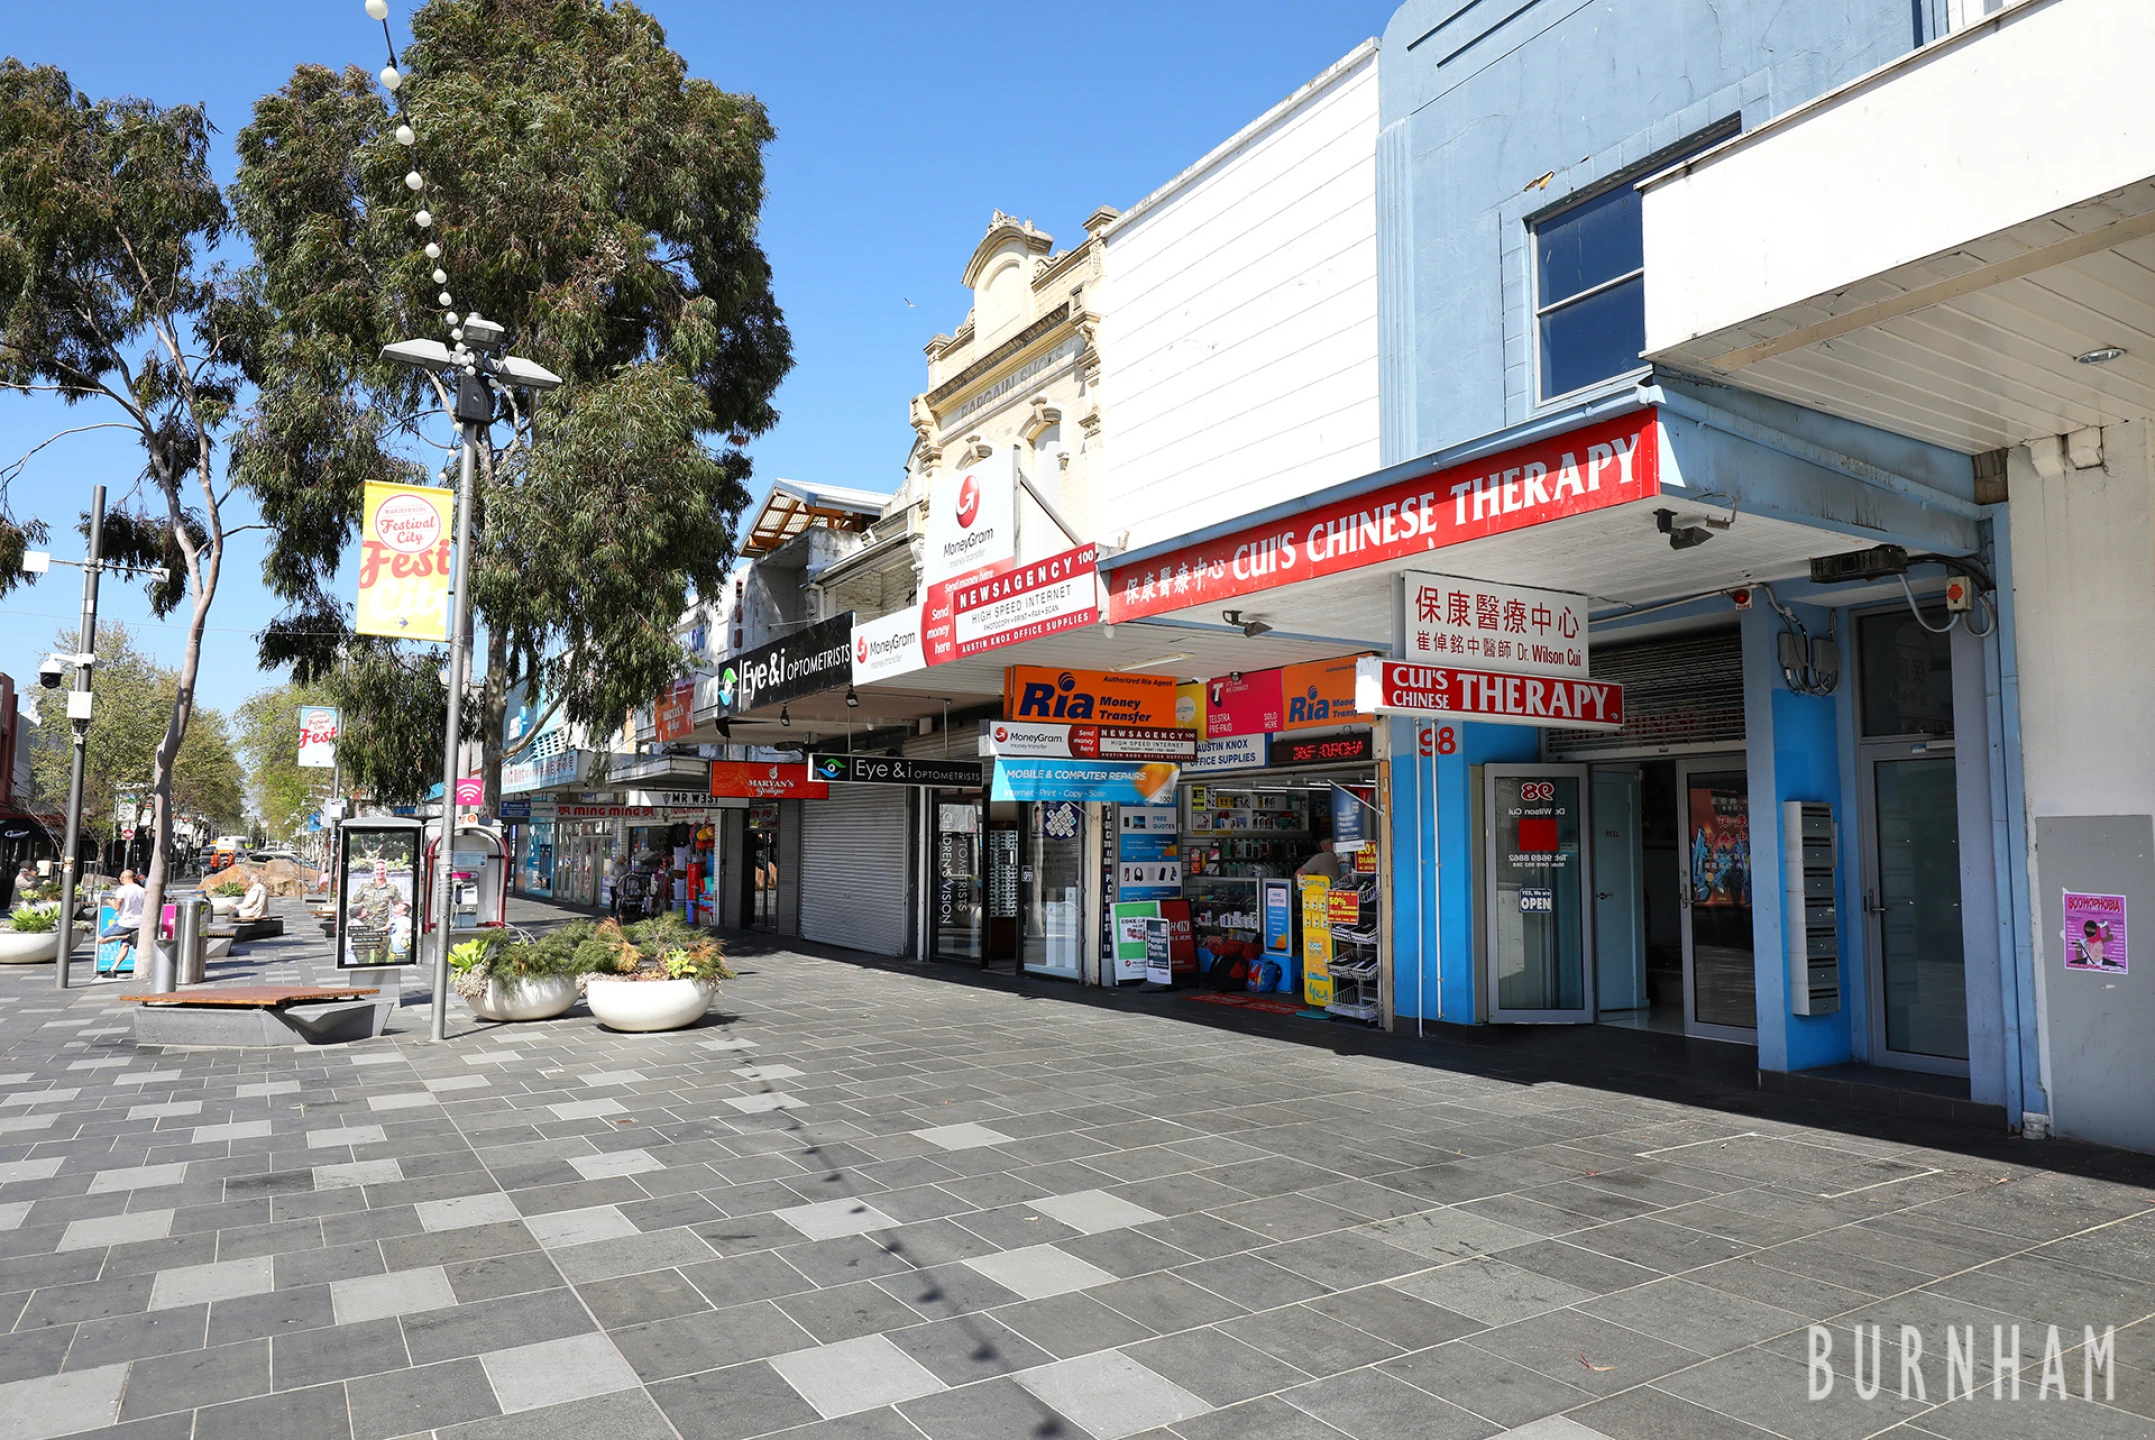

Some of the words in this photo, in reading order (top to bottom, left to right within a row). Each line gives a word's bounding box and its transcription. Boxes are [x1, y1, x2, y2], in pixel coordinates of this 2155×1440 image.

[961, 376, 1016, 420] BARGAIN
[1020, 346, 1066, 390] SHOES
[1233, 531, 1296, 580] CUI'S
[1306, 492, 1437, 562] CHINESE
[1450, 433, 1639, 526] THERAPY
[380, 515, 436, 533] Festival
[397, 531, 424, 545] City
[943, 527, 994, 558] MoneyGram
[950, 557, 970, 568] money
[944, 581, 956, 594] Send
[957, 577, 979, 589] money
[979, 569, 994, 583] here
[960, 557, 1072, 608] NEWSAGENCY
[1077, 549, 1094, 565] 100
[932, 604, 949, 621] Send
[971, 608, 992, 624] HIGH
[994, 599, 1022, 617] SPEED
[1025, 584, 1071, 608] INTERNET
[1415, 584, 1580, 639] 保康醫療中心
[1014, 612, 1028, 623] PRINT
[1045, 604, 1059, 615] SCAN
[926, 624, 950, 640] money
[962, 639, 988, 653] AUSTIN
[991, 633, 1010, 646] KNOX
[1014, 624, 1043, 640] OFFICE
[1046, 611, 1089, 631] SUPPLIES
[870, 632, 915, 656] MoneyGram
[934, 640, 951, 655] here
[1416, 630, 1512, 659] 崔倬銘中醫師
[1517, 644, 1529, 661] Dr.
[1532, 645, 1564, 665] Wilson
[1567, 648, 1581, 667] Cui
[786, 643, 851, 681] OPTOMETRISTS
[1103, 676, 1139, 685] Authorized
[1153, 679, 1173, 687] Agent
[1018, 672, 1094, 719] Ria
[1392, 666, 1449, 690] CUI'S
[1456, 672, 1608, 719] THERAPY
[1392, 689, 1449, 709] CHINESE
[1100, 696, 1140, 709] Money
[1288, 685, 1329, 723] Ria
[1099, 710, 1152, 724] Transfer
[1209, 713, 1231, 724] TELSTRA
[1264, 712, 1278, 721] SOLD
[1264, 720, 1278, 729] HERE
[1078, 729, 1094, 737] Send
[1101, 729, 1184, 740] NEWSAGENCY
[1209, 723, 1232, 734] PRE-PAID
[298, 727, 337, 748] Fest
[1010, 732, 1063, 743] MoneyGram
[1073, 738, 1094, 746] money
[1198, 742, 1223, 753] AUSTIN
[1226, 738, 1248, 749] KNOX
[1419, 726, 1456, 757] 98
[1218, 752, 1256, 765] SUPPLIES
[856, 760, 888, 781] Eye
[893, 762, 906, 778] &
[914, 770, 980, 781] OPTOMETRISTS
[1006, 769, 1044, 779] MOBILE
[1046, 770, 1052, 779] &
[1055, 770, 1106, 780] COMPUTER
[1108, 772, 1147, 781] REPAIRS
[672, 793, 687, 803] MR
[1039, 789, 1056, 797] Print
[1063, 789, 1082, 799] Copy
[957, 825, 968, 912] OPTOMETRISTS
[942, 879, 953, 924] VISION
[1329, 897, 1346, 906] 50%
[1521, 897, 1550, 910] OPEN
